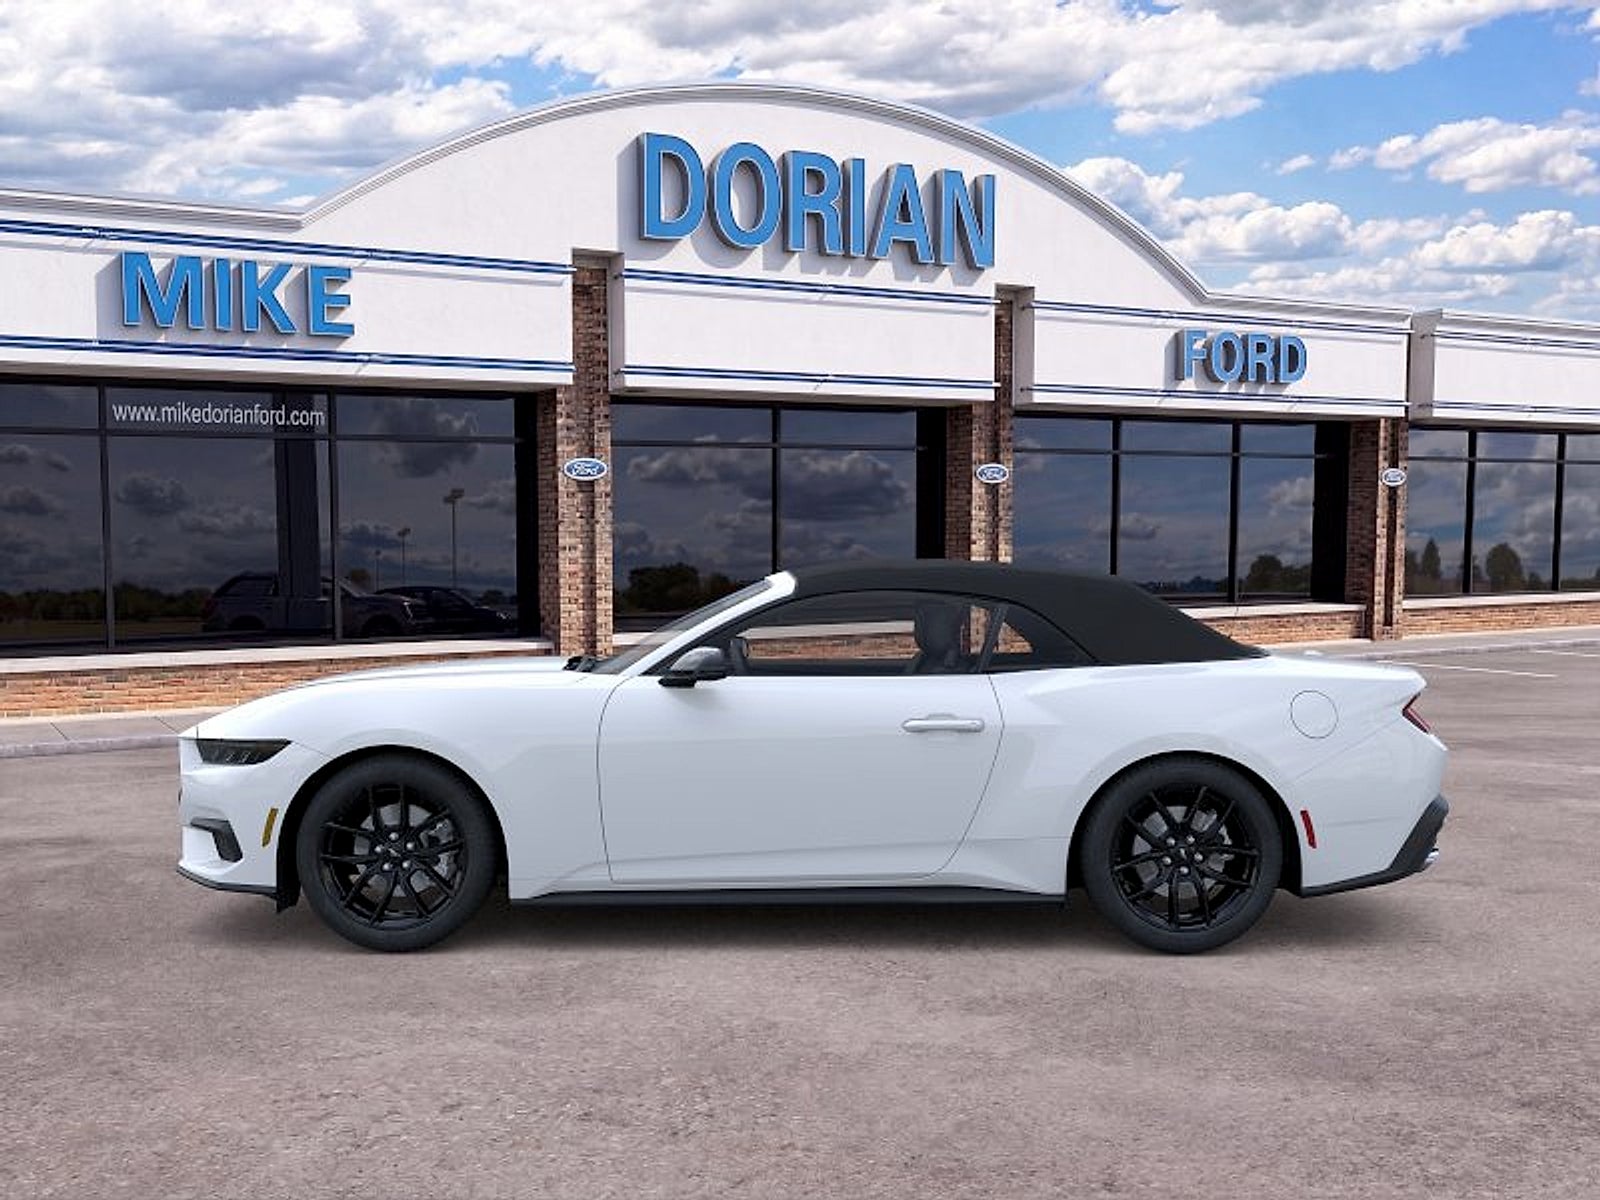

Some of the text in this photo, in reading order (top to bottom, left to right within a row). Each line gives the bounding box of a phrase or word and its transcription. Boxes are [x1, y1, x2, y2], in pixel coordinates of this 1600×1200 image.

[639, 132, 996, 270] DORIAN
[120, 251, 355, 337] MIKE
[1178, 329, 1308, 384] FORD
[111, 402, 325, 426] www.mikedorianford.com
